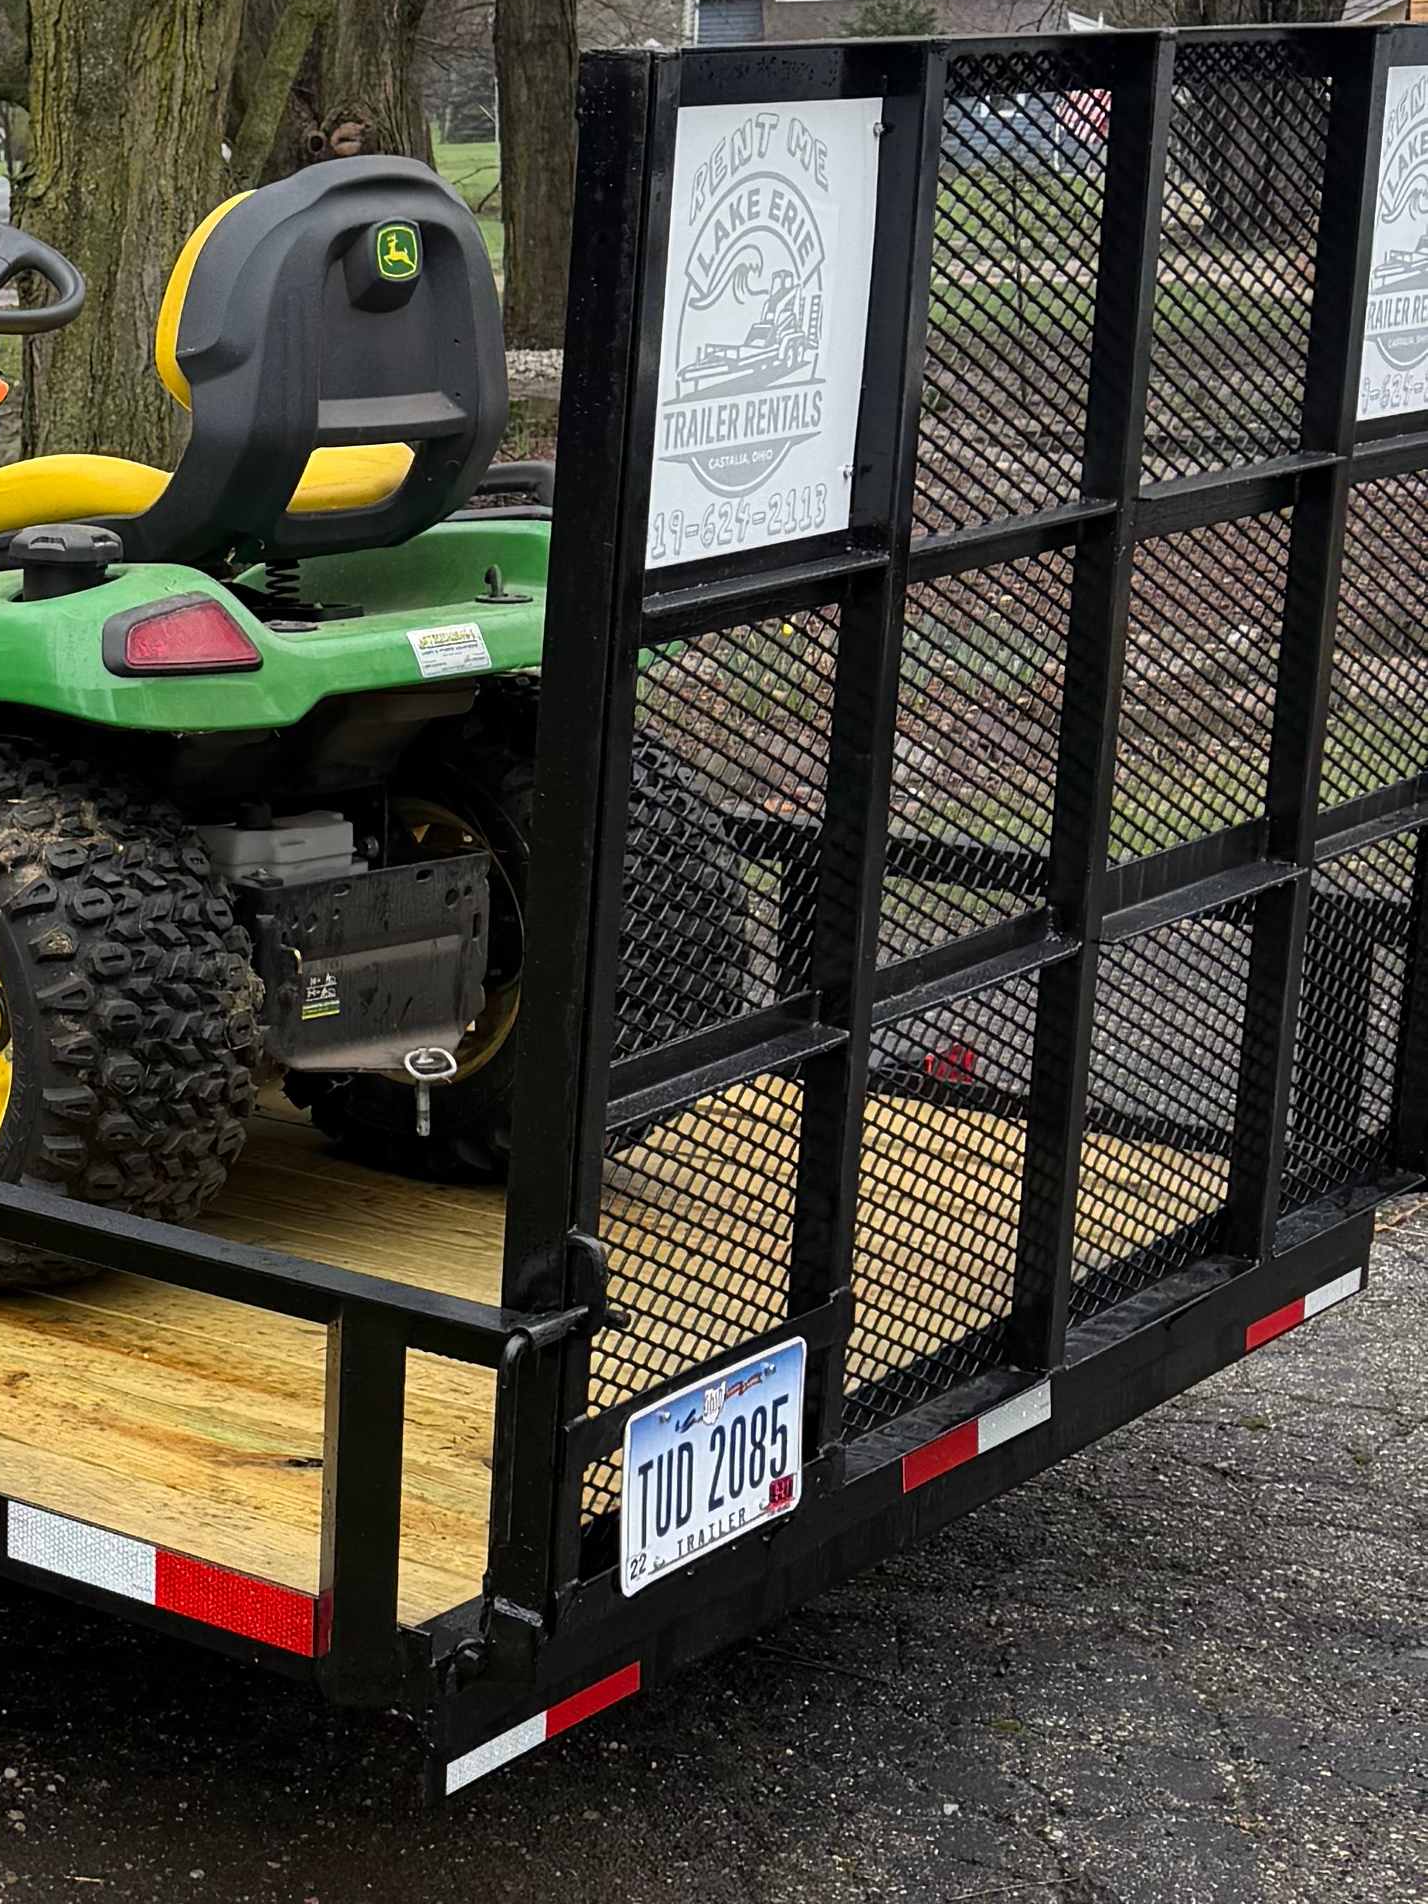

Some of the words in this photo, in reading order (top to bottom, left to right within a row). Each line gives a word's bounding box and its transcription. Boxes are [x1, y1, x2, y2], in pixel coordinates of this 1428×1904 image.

[689, 112, 780, 227] RENT
[787, 118, 829, 193] ME
[697, 188, 761, 278] LAKE
[768, 189, 815, 267] ERIE
[1366, 296, 1411, 331] RAILER
[663, 402, 740, 452] TRAILER
[744, 390, 823, 439] RENTALS
[651, 482, 828, 560] 19-624-2113
[638, 1441, 693, 1550] TUD
[708, 1394, 789, 1513] 2085
[630, 1553, 647, 1581] 22
[677, 1508, 746, 1557] TRAILER
